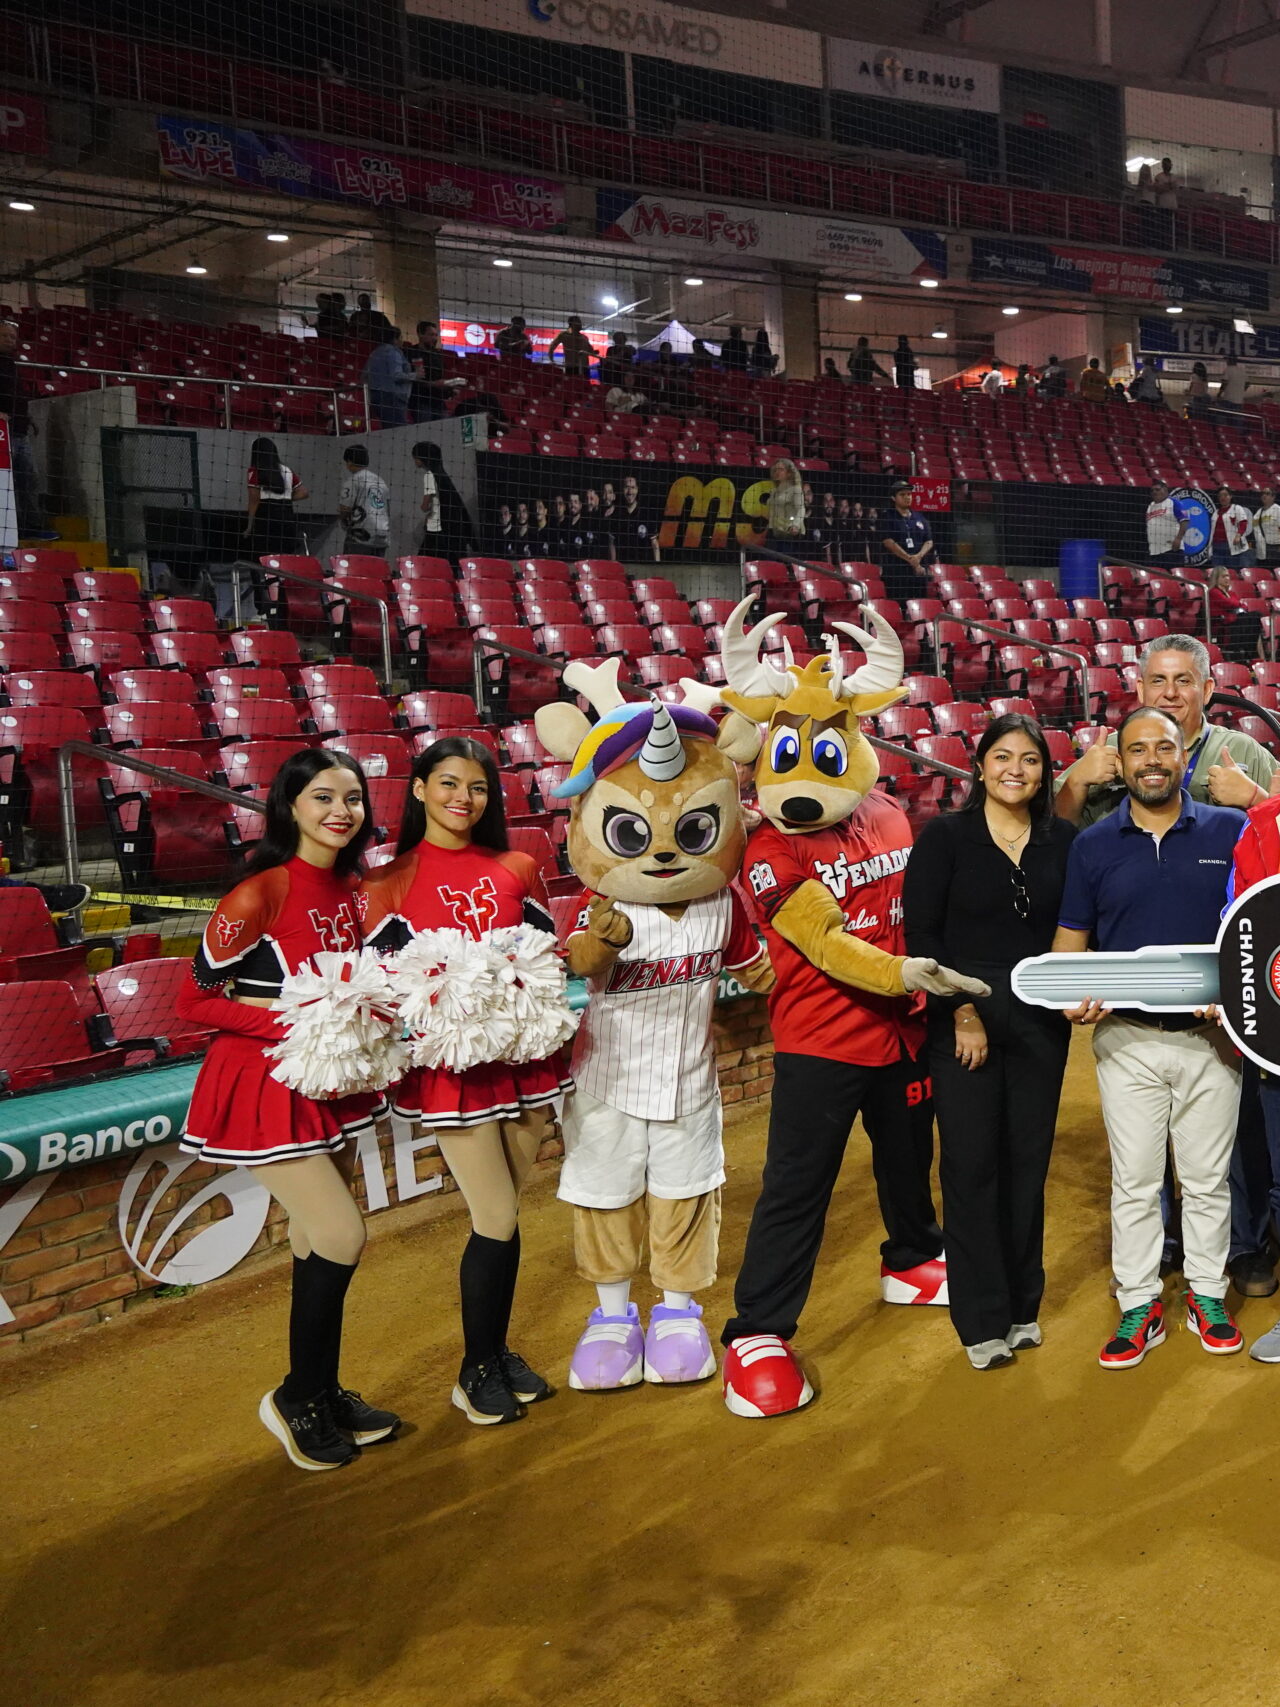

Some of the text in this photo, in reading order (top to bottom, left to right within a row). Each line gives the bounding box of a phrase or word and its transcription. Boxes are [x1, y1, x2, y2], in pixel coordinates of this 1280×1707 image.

[559, 0, 722, 56] COSAMED
[1053, 254, 1075, 271] Los
[1170, 322, 1258, 356] TECATE
[1238, 917, 1258, 1036] CHANGAN
[36, 1114, 171, 1173] Banco
